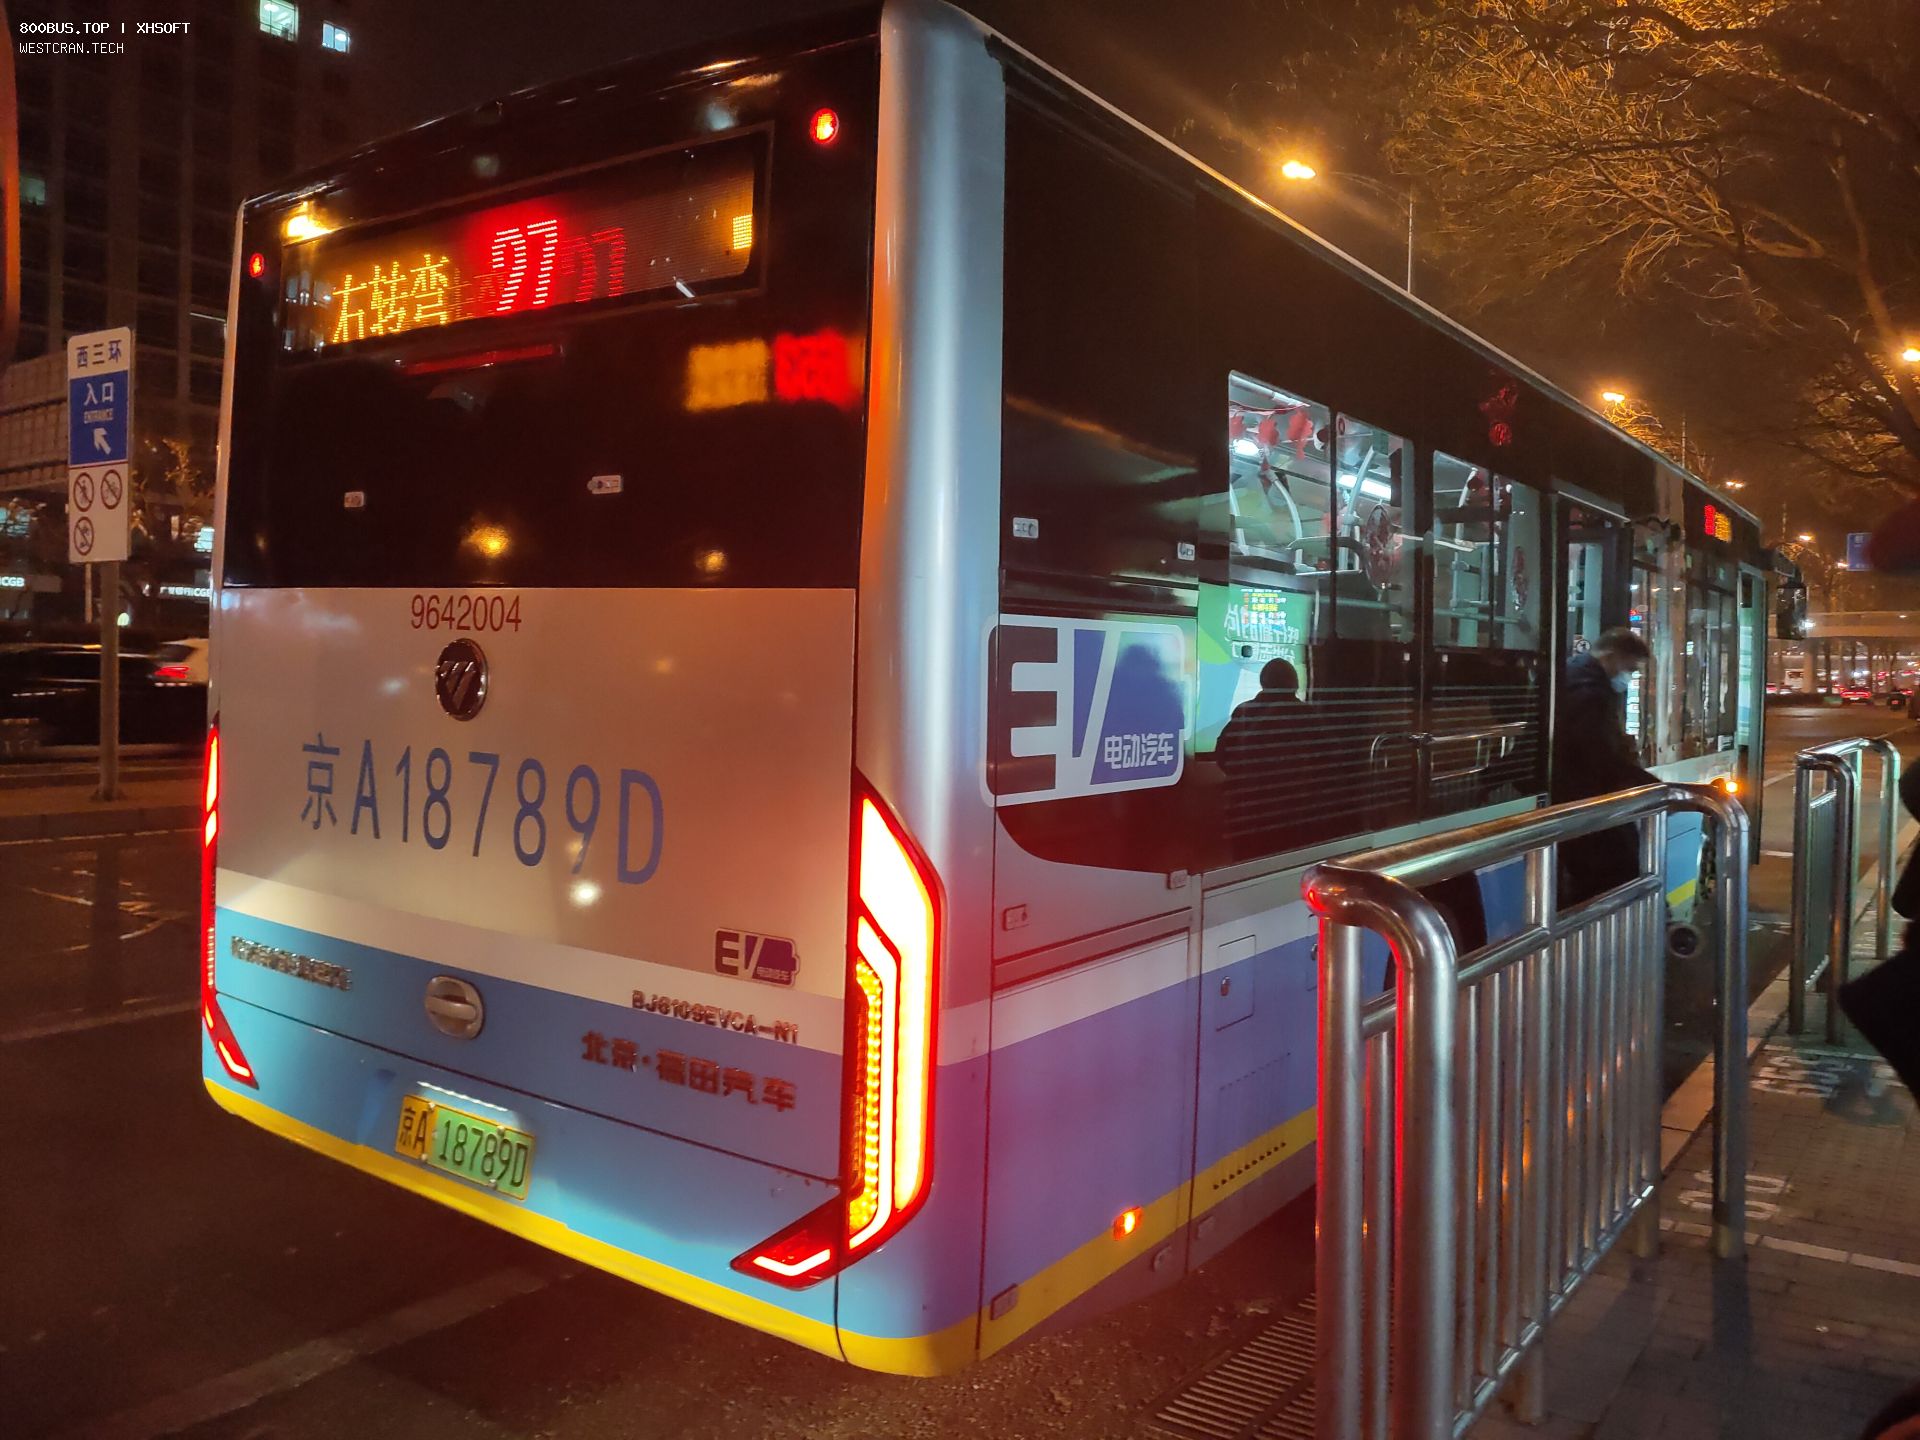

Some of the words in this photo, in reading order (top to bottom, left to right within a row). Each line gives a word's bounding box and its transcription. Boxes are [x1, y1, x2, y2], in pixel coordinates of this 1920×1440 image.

[76, 339, 122, 368] 西三环
[83, 381, 115, 406] 入口
[410, 594, 522, 632] 9642004
[1104, 733, 1174, 769] 电动汽车
[301, 732, 664, 885] 京A18789D
[439, 1119, 529, 1188] 18789D
